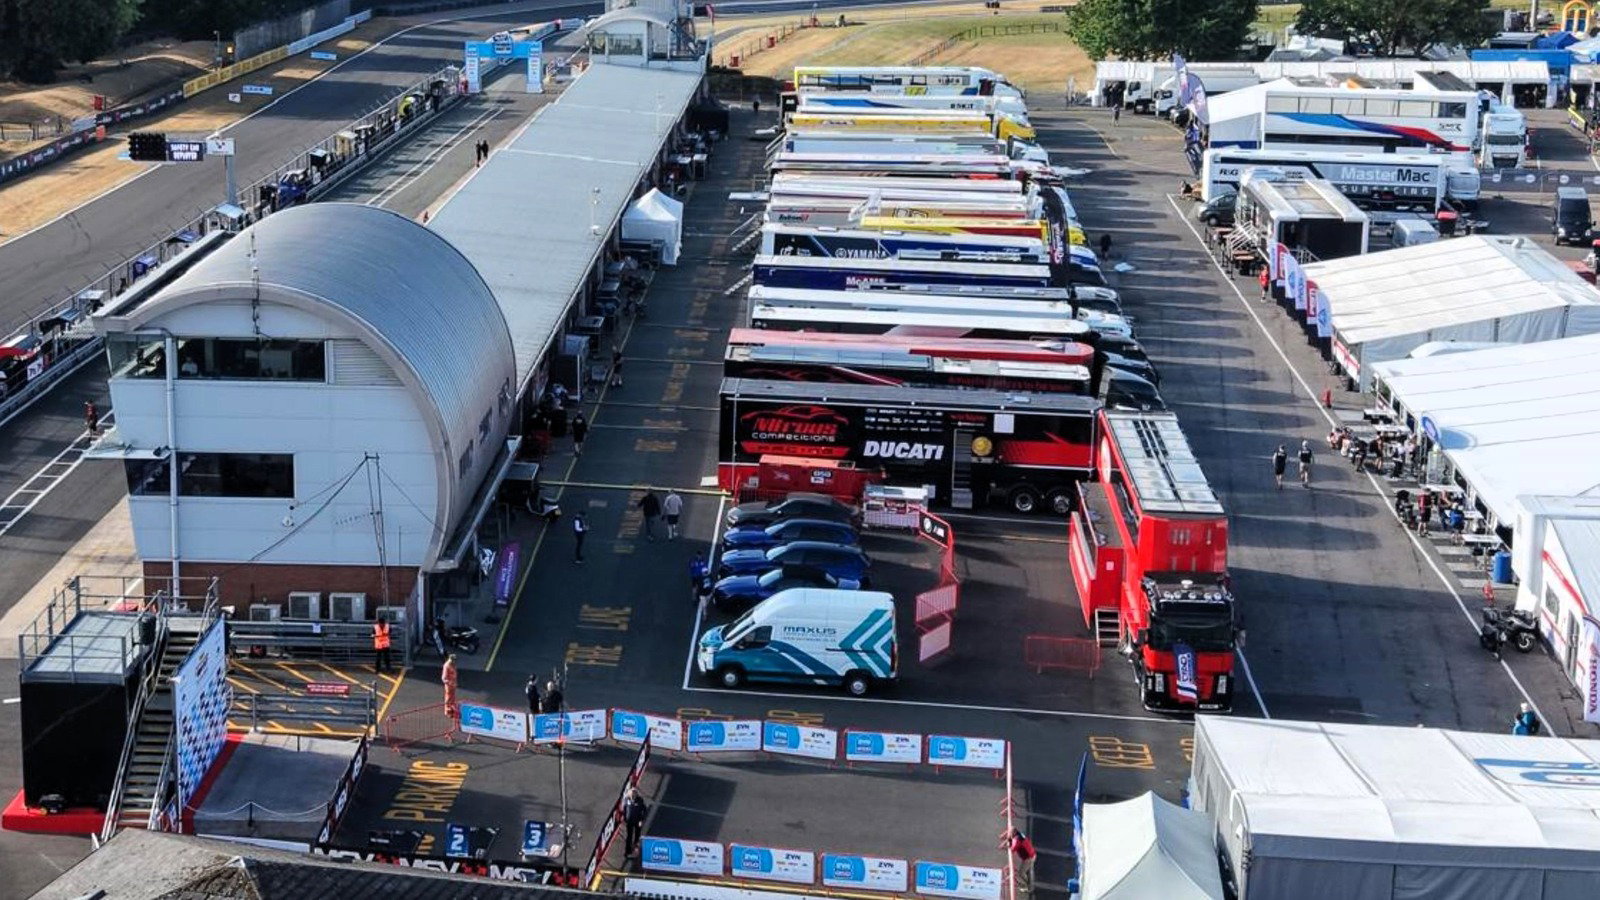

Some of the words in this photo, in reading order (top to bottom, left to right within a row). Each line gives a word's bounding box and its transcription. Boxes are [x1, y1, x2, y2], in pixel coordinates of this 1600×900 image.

[170, 143, 189, 151] SAFETY
[1341, 166, 1431, 182] MasterMac
[847, 248, 886, 259] YAMAHA
[863, 440, 945, 460] DUCATI
[383, 760, 470, 822] PARKING
[451, 833, 465, 850] 2
[528, 829, 541, 846] 3
[694, 845, 710, 853] ZYN
[878, 861, 895, 869] ZYN
[972, 871, 988, 879] ZYN
